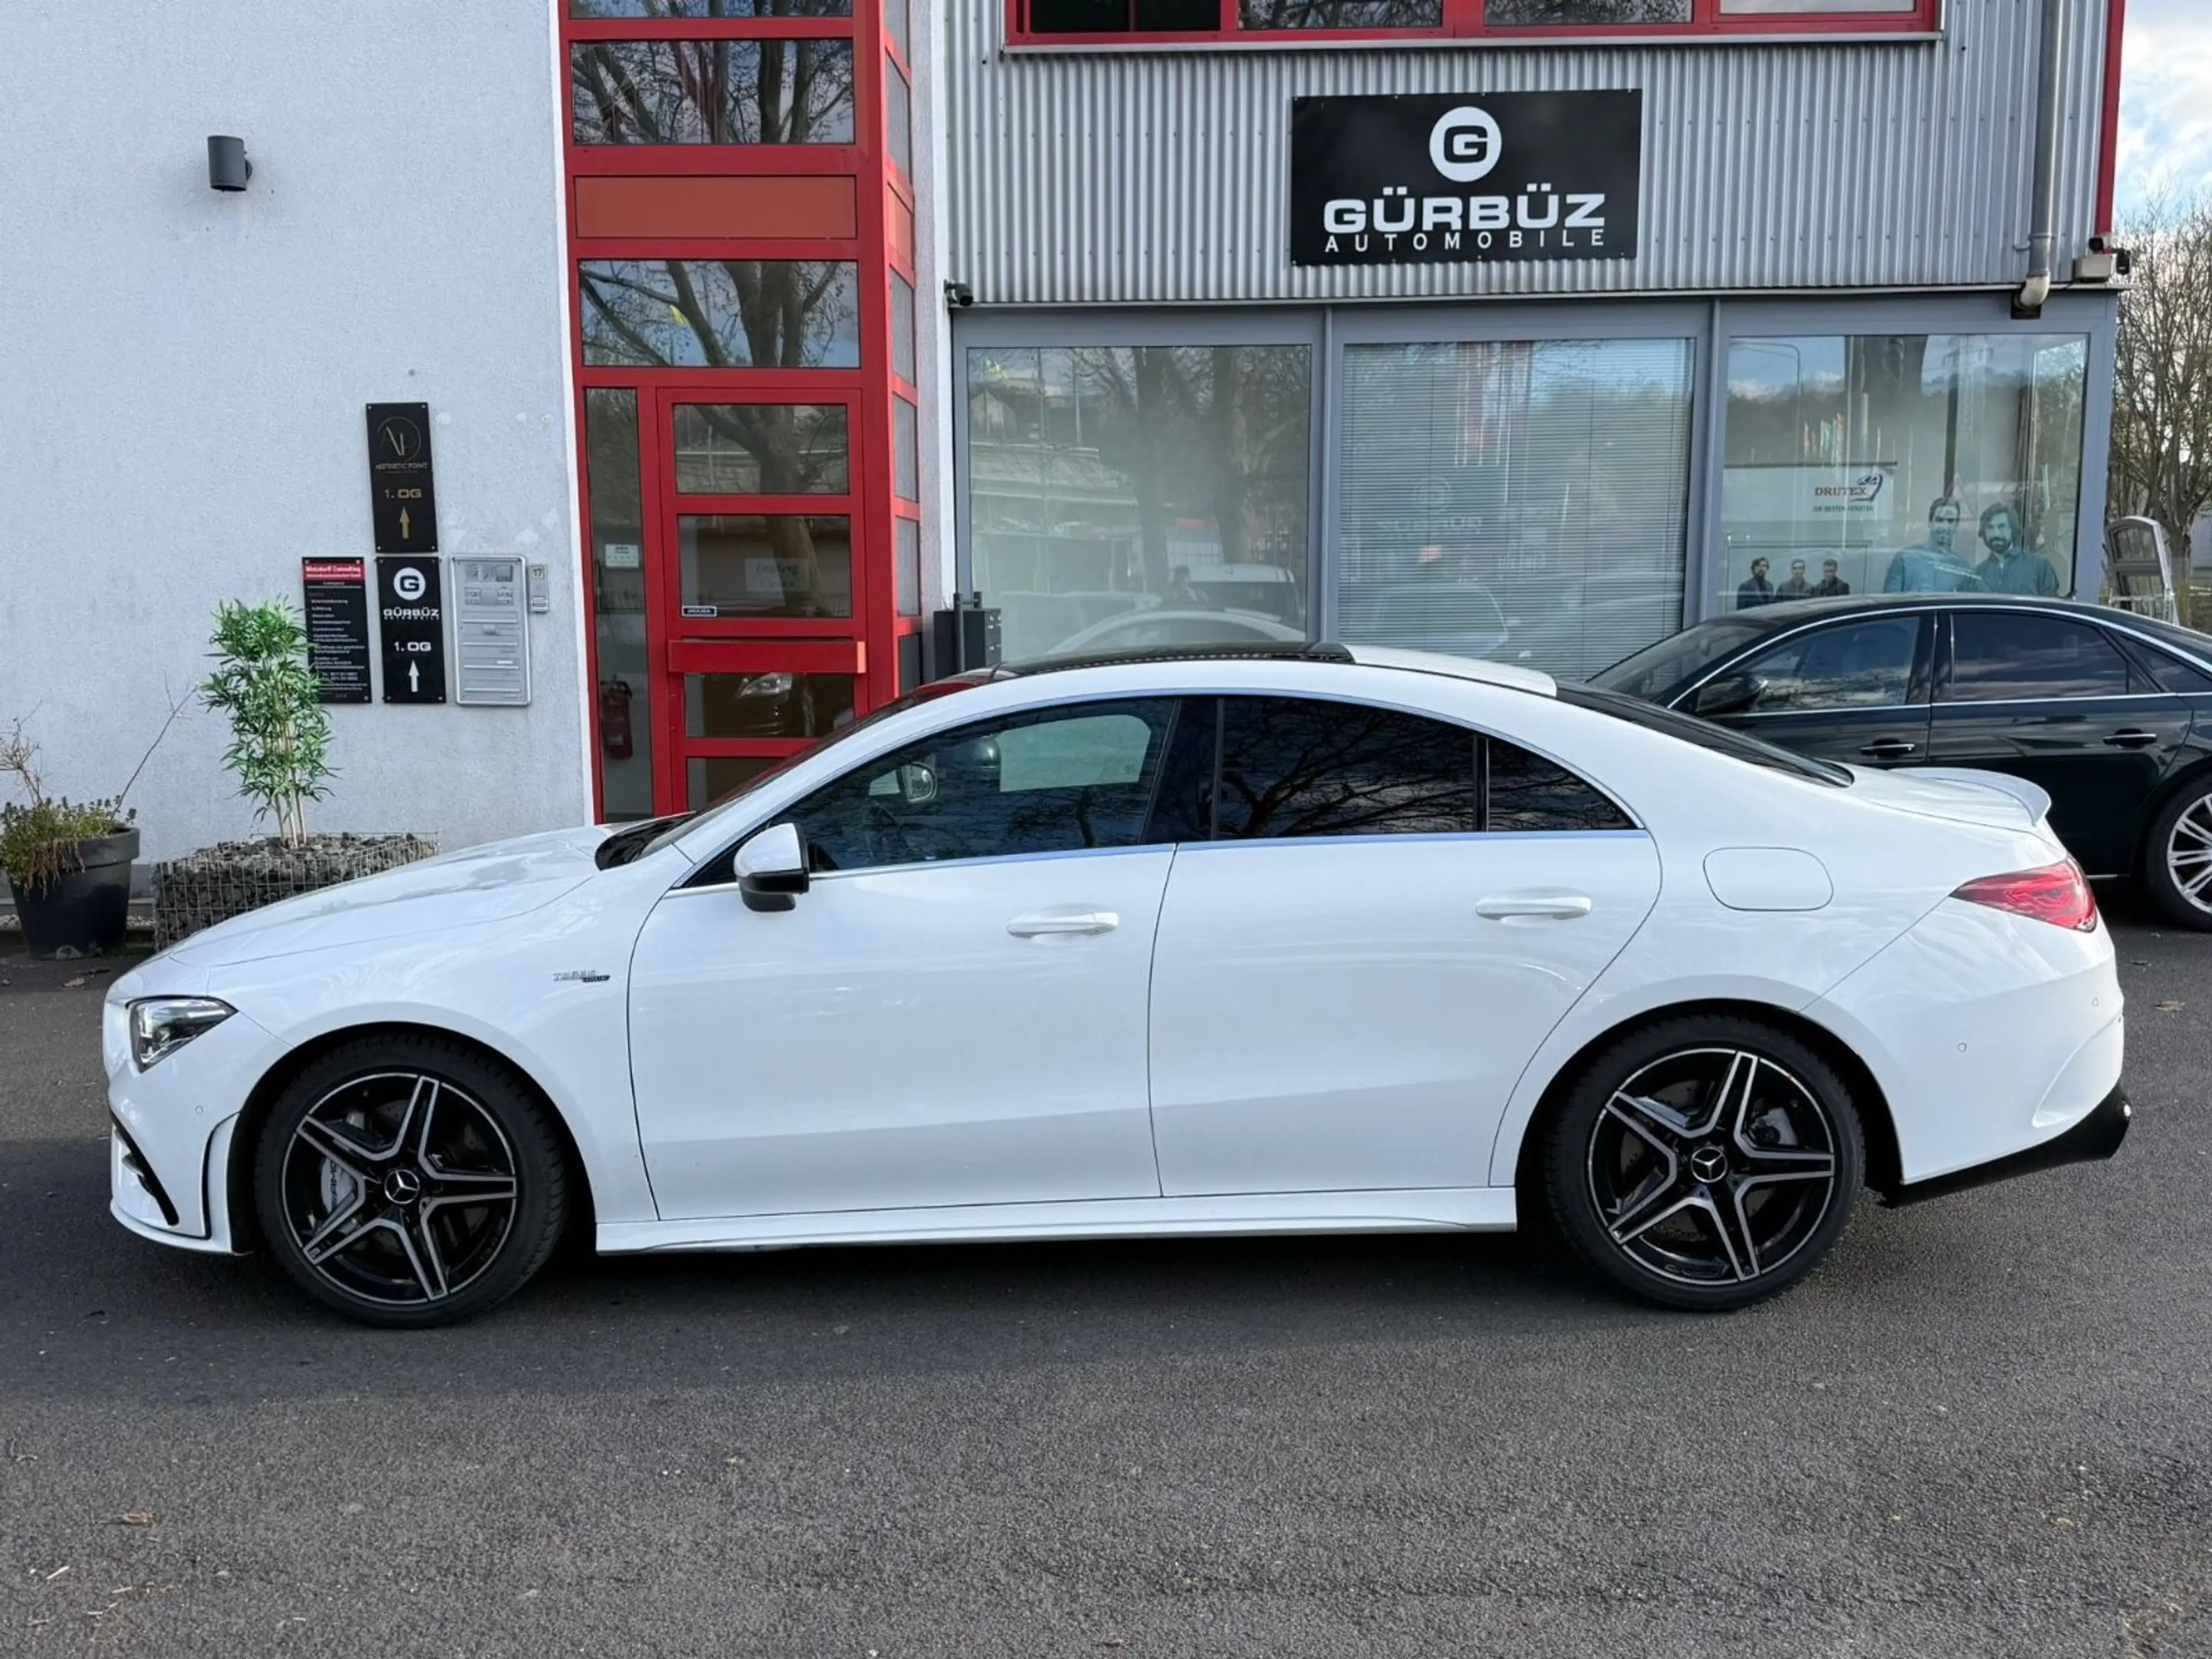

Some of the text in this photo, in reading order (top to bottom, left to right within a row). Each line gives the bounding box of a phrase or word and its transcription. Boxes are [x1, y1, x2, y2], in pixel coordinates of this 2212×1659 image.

[1444, 125, 1488, 164] G
[1323, 183, 1605, 233] GÜRBÜZ
[1324, 229, 1604, 252] AUTOMOBILE
[385, 488, 422, 499] 1. OG
[1815, 486, 1867, 496] DRUTEX
[400, 575, 420, 592] G
[383, 606, 440, 618] GÜRBÜZ
[394, 641, 431, 652] 1. OG
